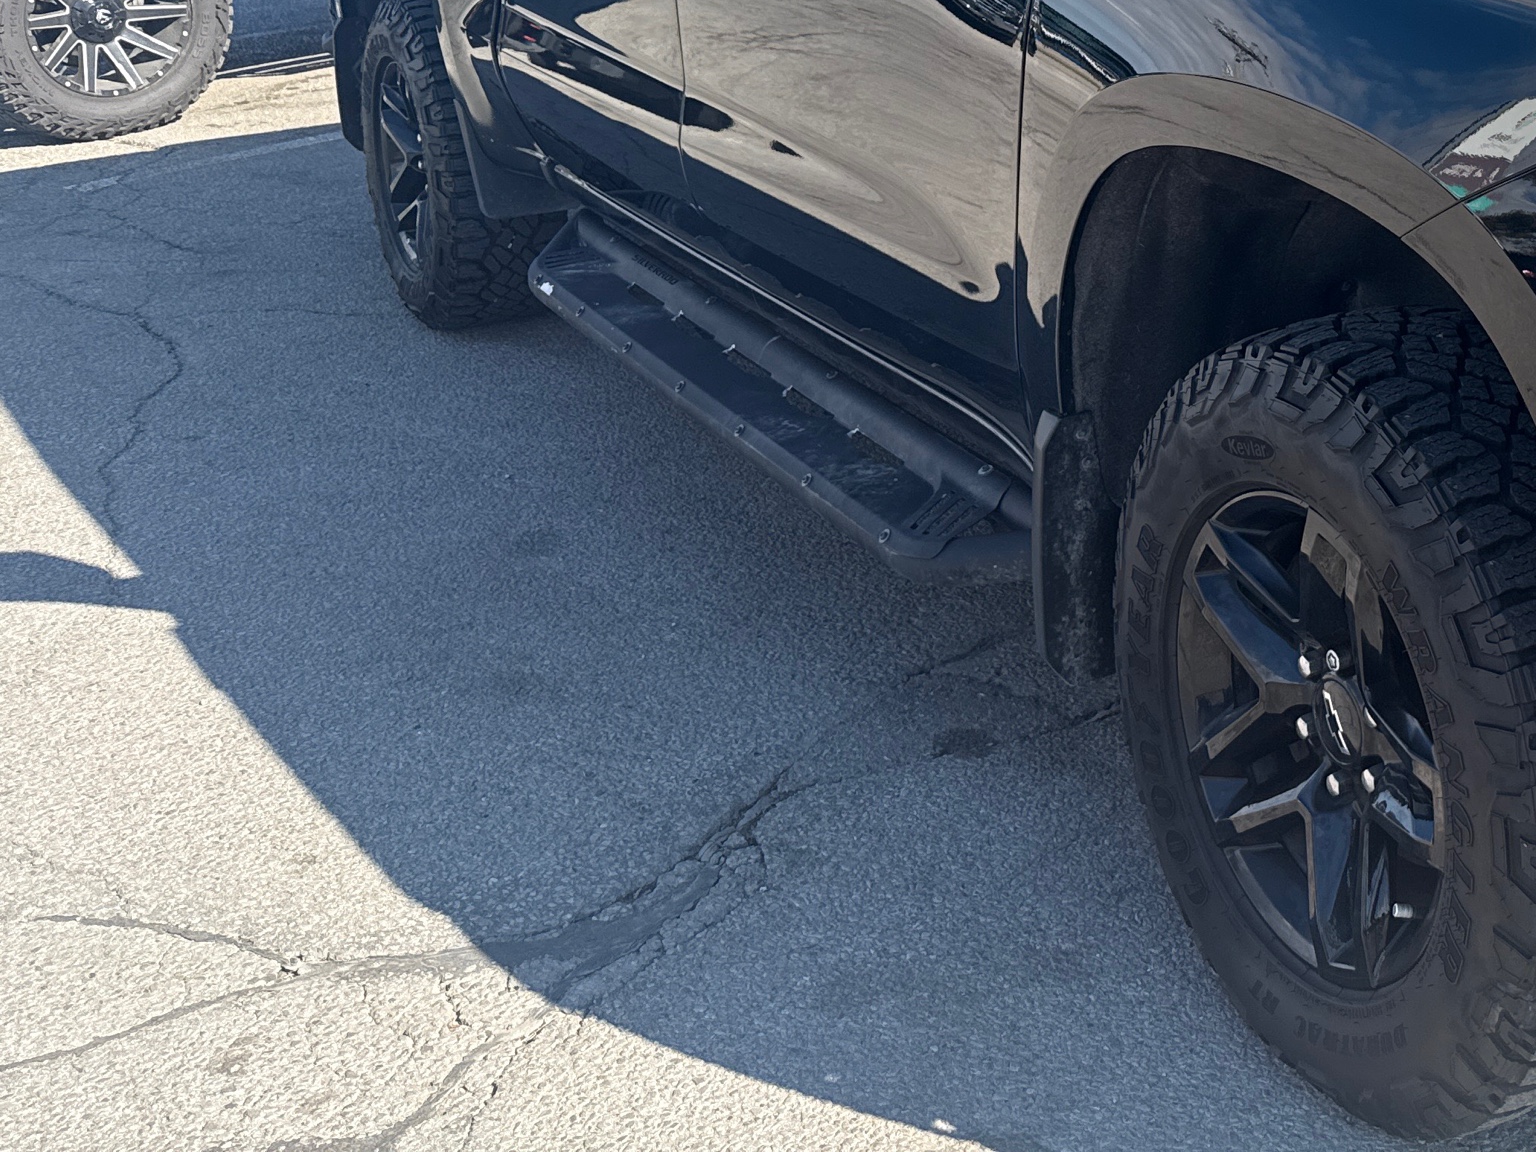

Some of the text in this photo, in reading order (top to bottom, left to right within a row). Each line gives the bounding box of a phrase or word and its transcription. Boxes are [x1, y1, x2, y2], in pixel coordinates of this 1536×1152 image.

[1227, 437, 1267, 458] Kevlar
[1126, 522, 1208, 906] GOODYEAR
[1381, 561, 1475, 986] WRANGLER
